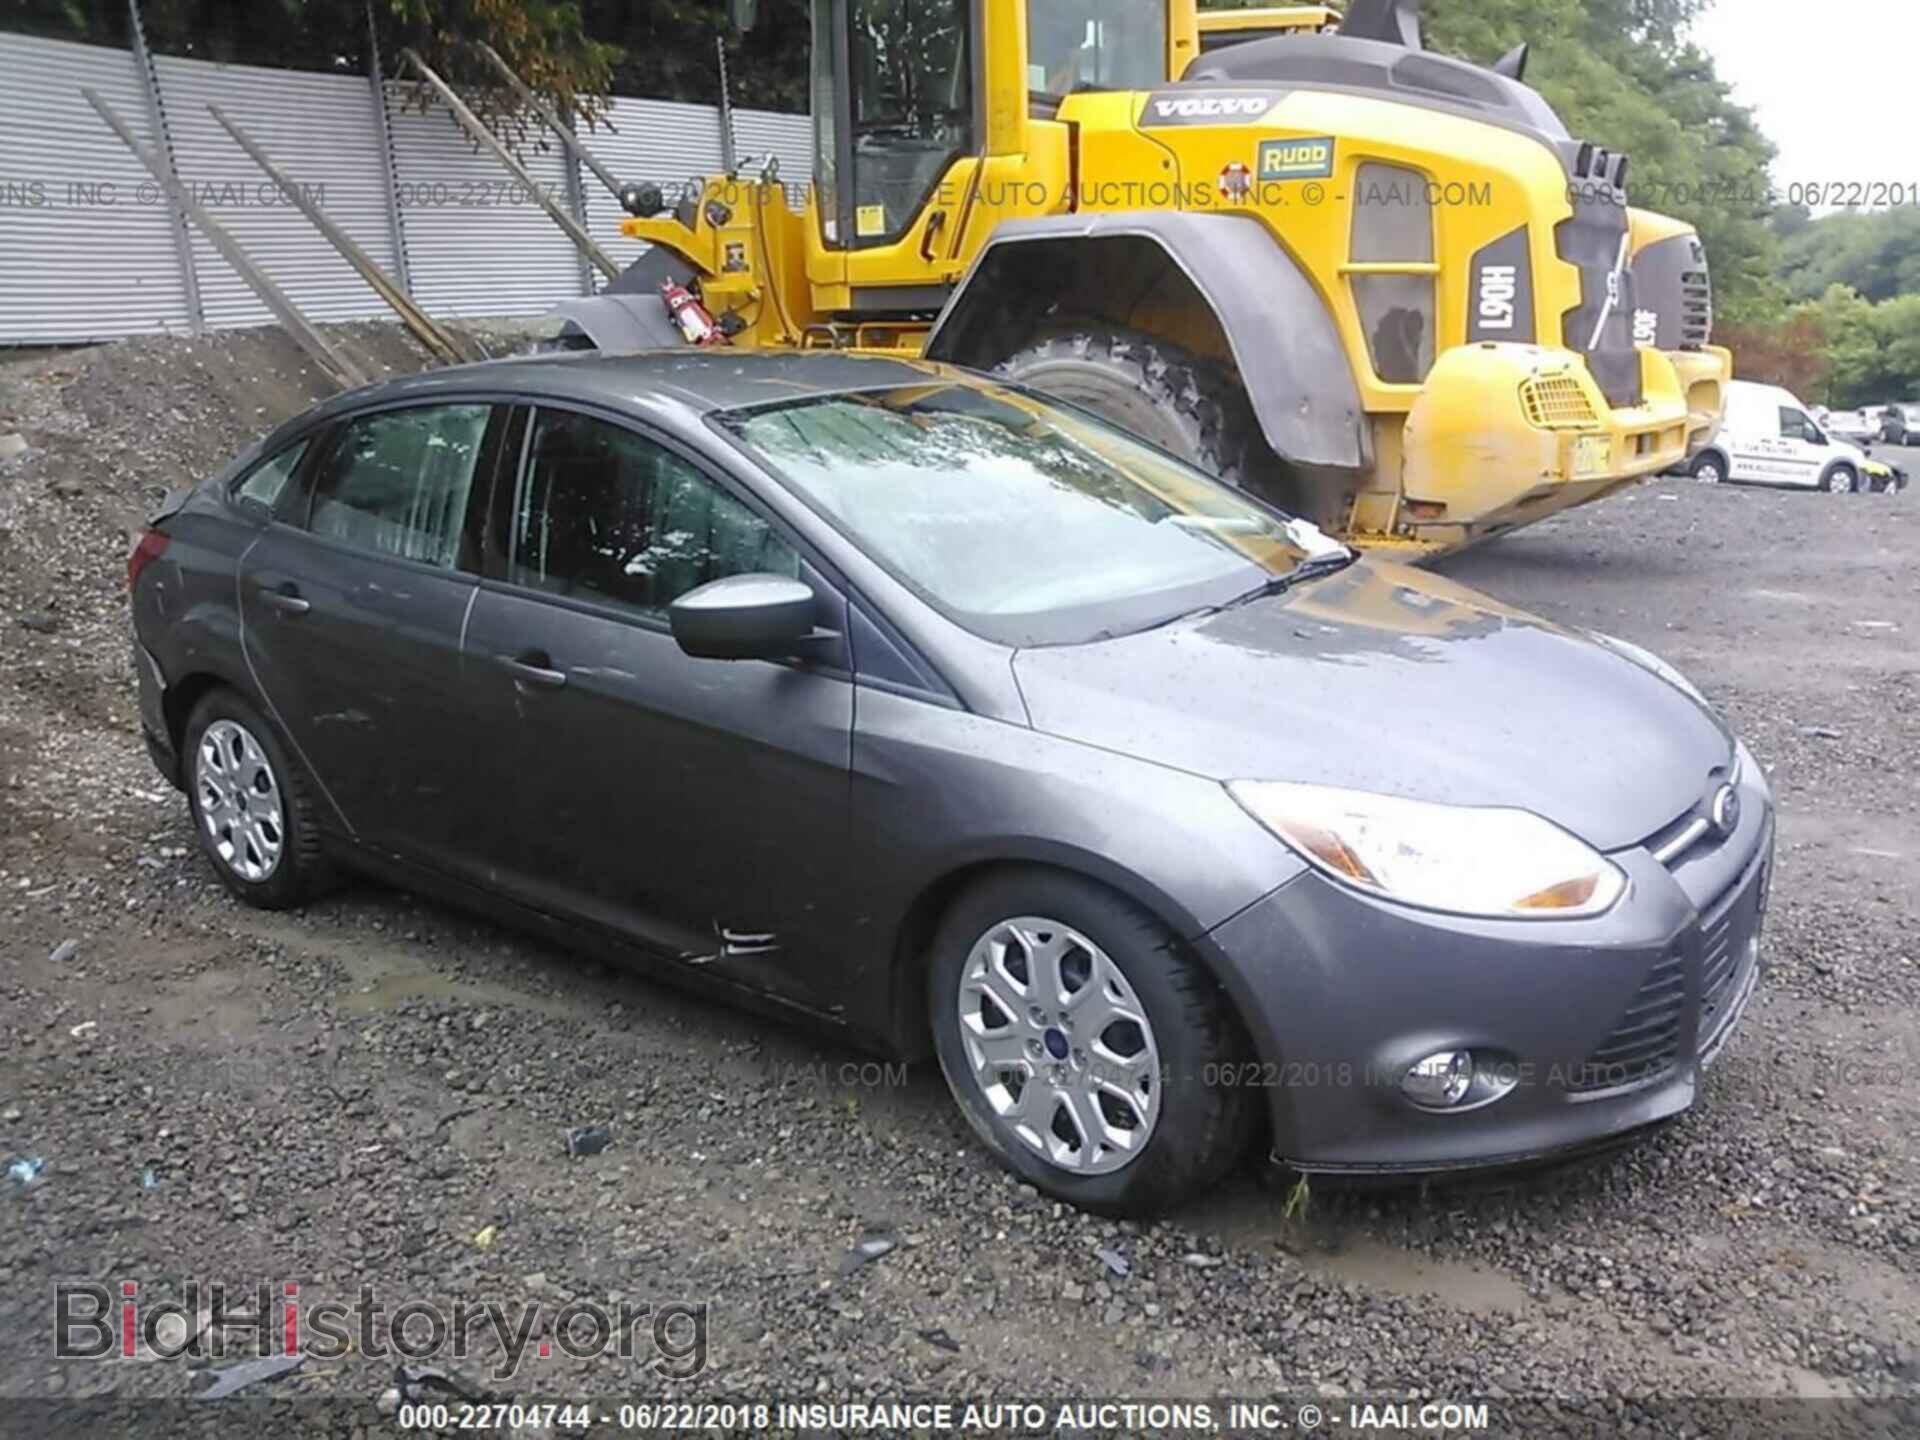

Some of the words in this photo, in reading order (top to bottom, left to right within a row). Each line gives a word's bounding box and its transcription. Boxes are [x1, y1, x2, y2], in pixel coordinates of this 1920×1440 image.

[1153, 96, 1268, 117] VOLVO
[1263, 144, 1328, 173] RUDD
[1478, 265, 1516, 328] L90H
